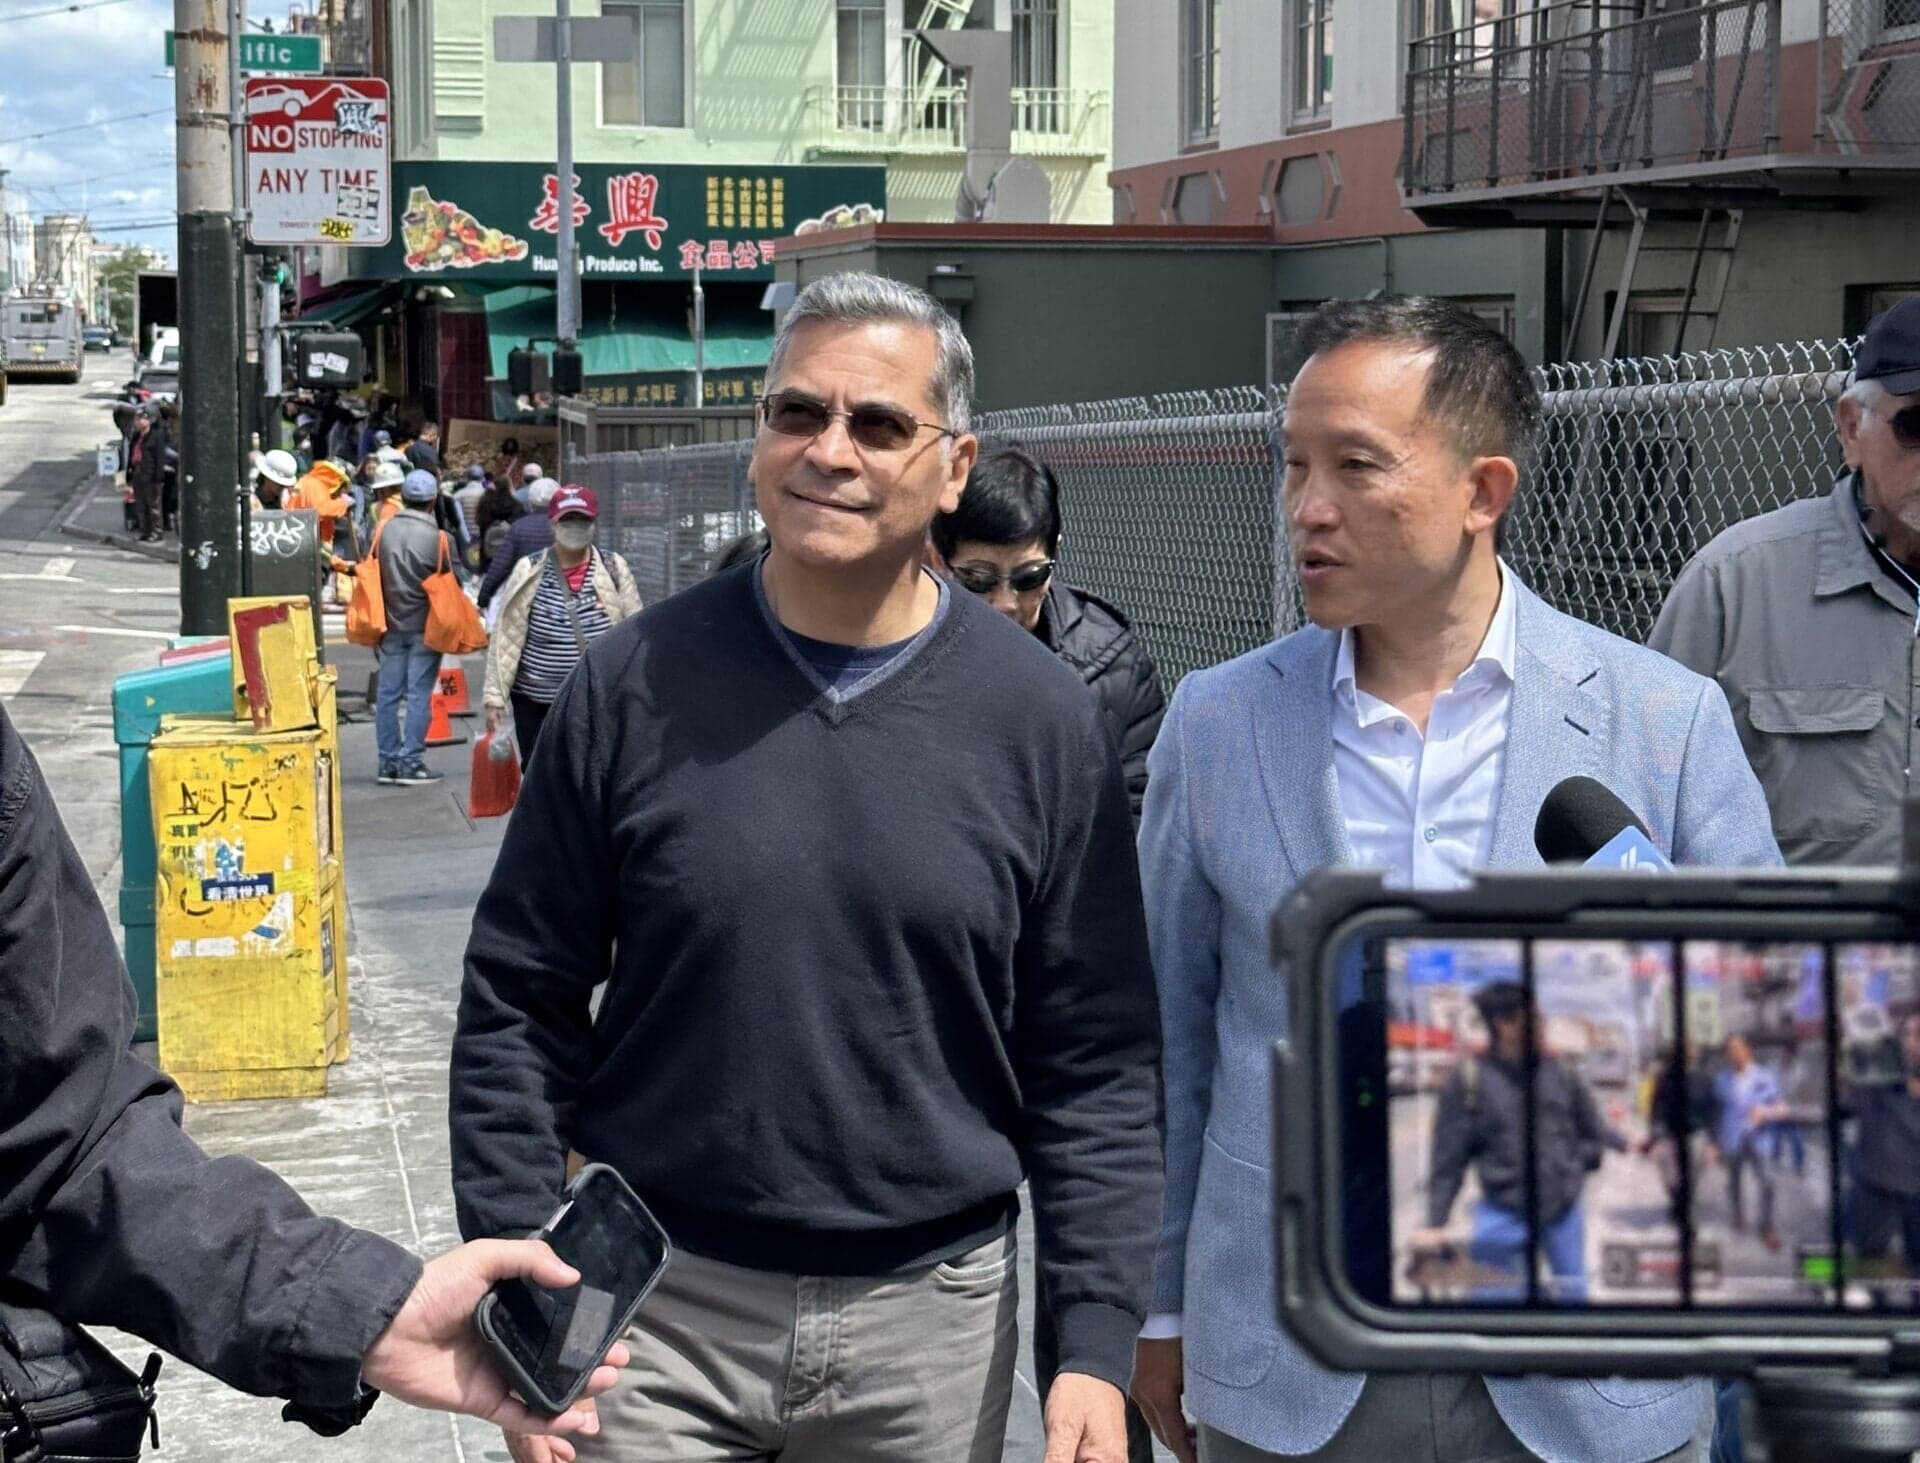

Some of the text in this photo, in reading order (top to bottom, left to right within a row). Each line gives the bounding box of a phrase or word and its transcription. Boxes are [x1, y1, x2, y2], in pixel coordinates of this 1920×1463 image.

[251, 125, 382, 149] NO STOPPING
[257, 168, 379, 195] ANY TIME
[585, 255, 638, 273] Produce
[638, 255, 664, 272] Inc.
[677, 239, 775, 270] 食品公司
